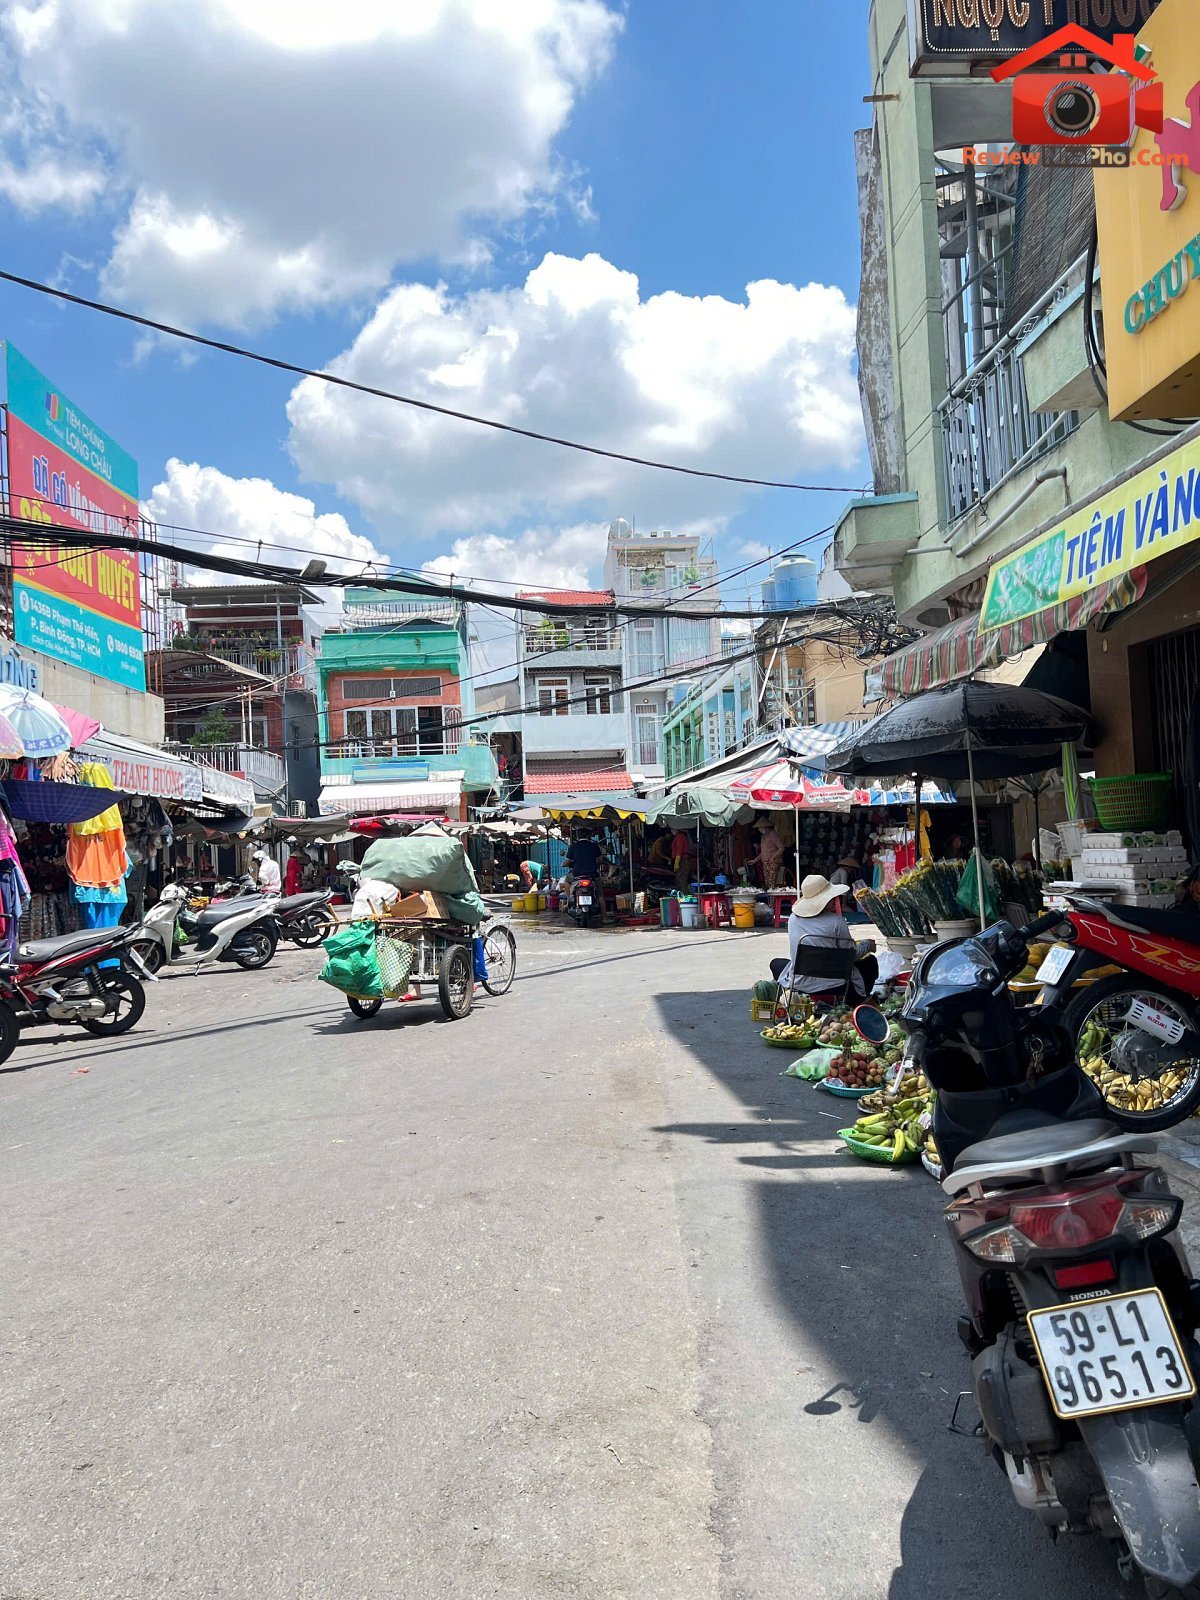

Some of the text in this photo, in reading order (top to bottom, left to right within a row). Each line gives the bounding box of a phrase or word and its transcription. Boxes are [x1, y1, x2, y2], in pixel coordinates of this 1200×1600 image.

[66, 428, 112, 480] LONG CHÂU
[33, 455, 49, 499] ĐÃ
[52, 471, 67, 512] CÓ
[1066, 468, 1200, 585] TIỆM VÀN
[98, 549, 135, 611] HUYẾT
[31, 616, 39, 630] P.
[87, 642, 101, 658] HCM
[113, 760, 150, 792] THANH
[1147, 1015, 1168, 1029] SUZUKI
[1070, 1288, 1112, 1301] HONDA
[1050, 1301, 1150, 1356] 59-L1
[1055, 1346, 1182, 1407] 965.13
